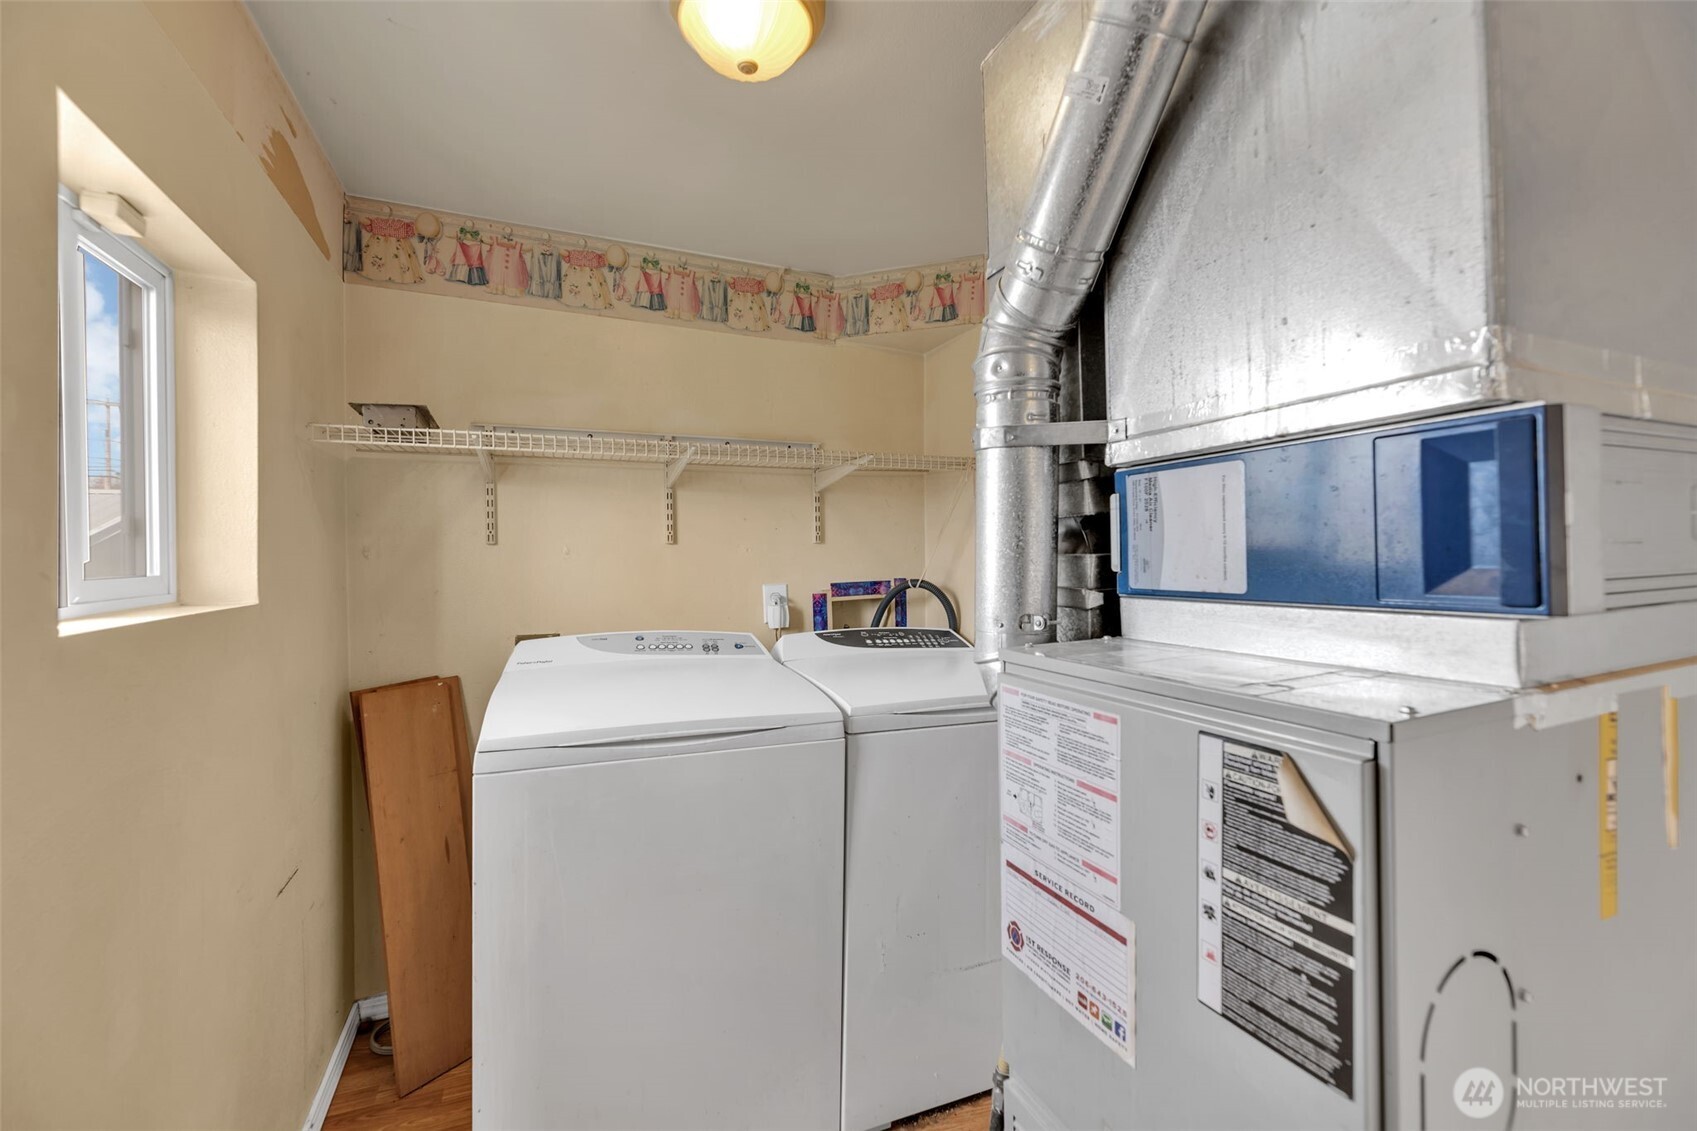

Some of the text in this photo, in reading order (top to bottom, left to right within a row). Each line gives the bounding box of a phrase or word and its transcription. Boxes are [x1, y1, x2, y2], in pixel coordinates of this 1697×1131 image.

[1034, 869, 1062, 893] SERVICE
[1064, 888, 1095, 913] RECORD
[1036, 943, 1071, 976] RESPONSE
